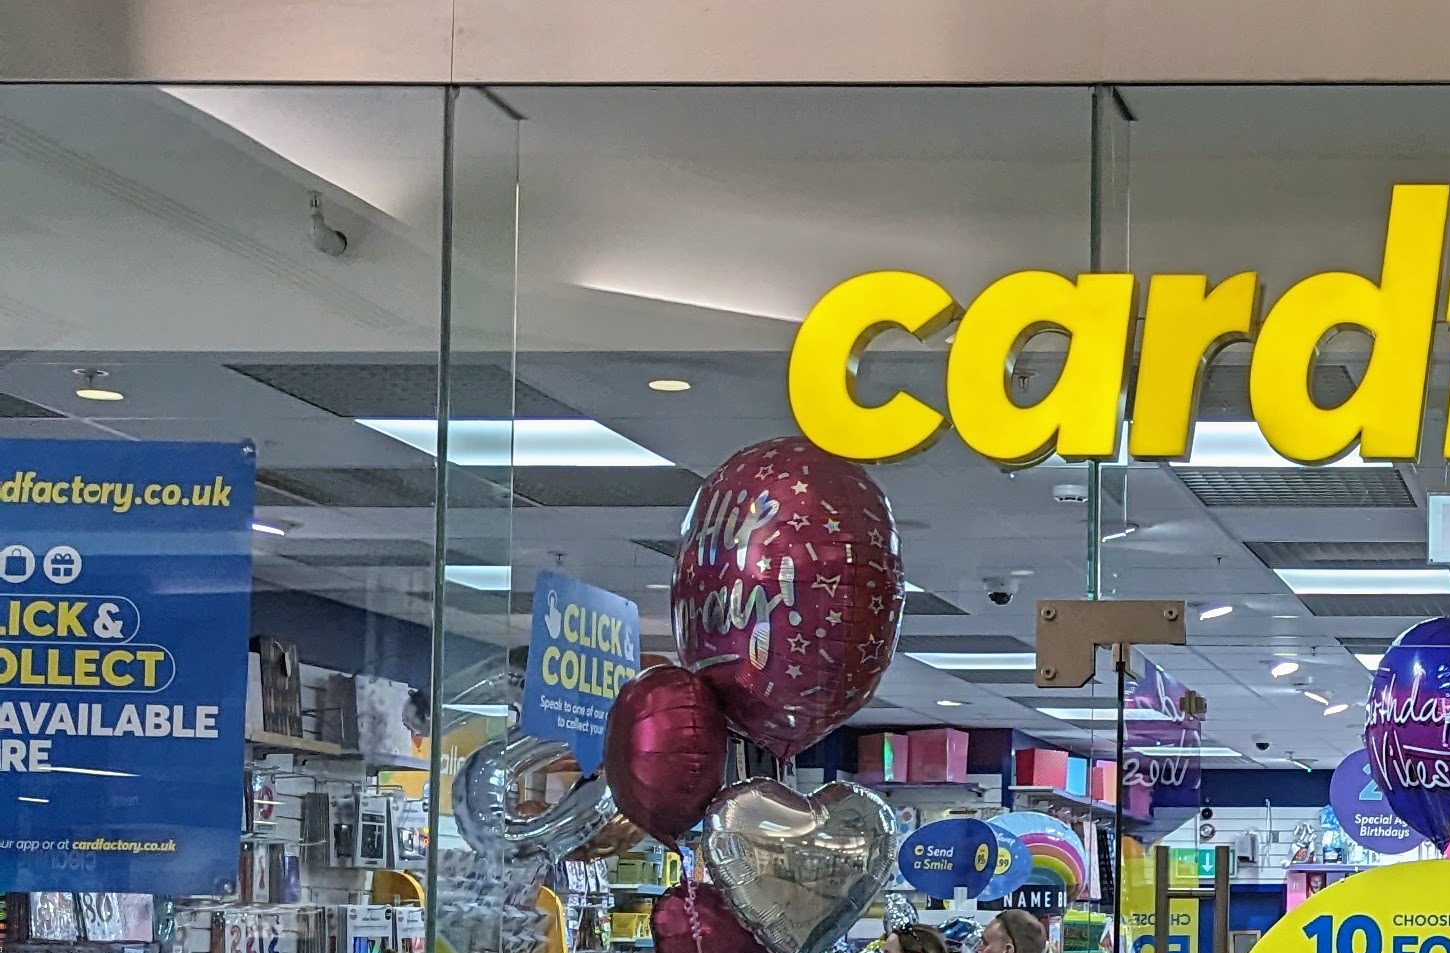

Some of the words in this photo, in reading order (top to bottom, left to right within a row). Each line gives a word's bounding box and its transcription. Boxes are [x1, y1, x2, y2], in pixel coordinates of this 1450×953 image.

[0, 471, 232, 513] dfactory.co.uk
[93, 602, 124, 639] &
[563, 603, 622, 655] CLICK
[624, 626, 635, 661] &
[540, 695, 563, 712] Speak
[564, 699, 571, 712] to
[573, 703, 586, 717] one
[0, 701, 219, 739] AVAILABLE
[557, 717, 565, 728] to
[566, 716, 590, 732] collect
[0, 738, 52, 773] RE
[1354, 813, 1391, 825] Special
[1359, 827, 1410, 839] Birthdays
[16, 839, 40, 852] app
[42, 840, 55, 850] or
[57, 839, 70, 850] at
[72, 838, 176, 853] cardfactory.co.uk
[926, 845, 954, 858] Send
[913, 861, 921, 869] a
[923, 859, 953, 871] Smile
[1003, 891, 1051, 908] NAME
